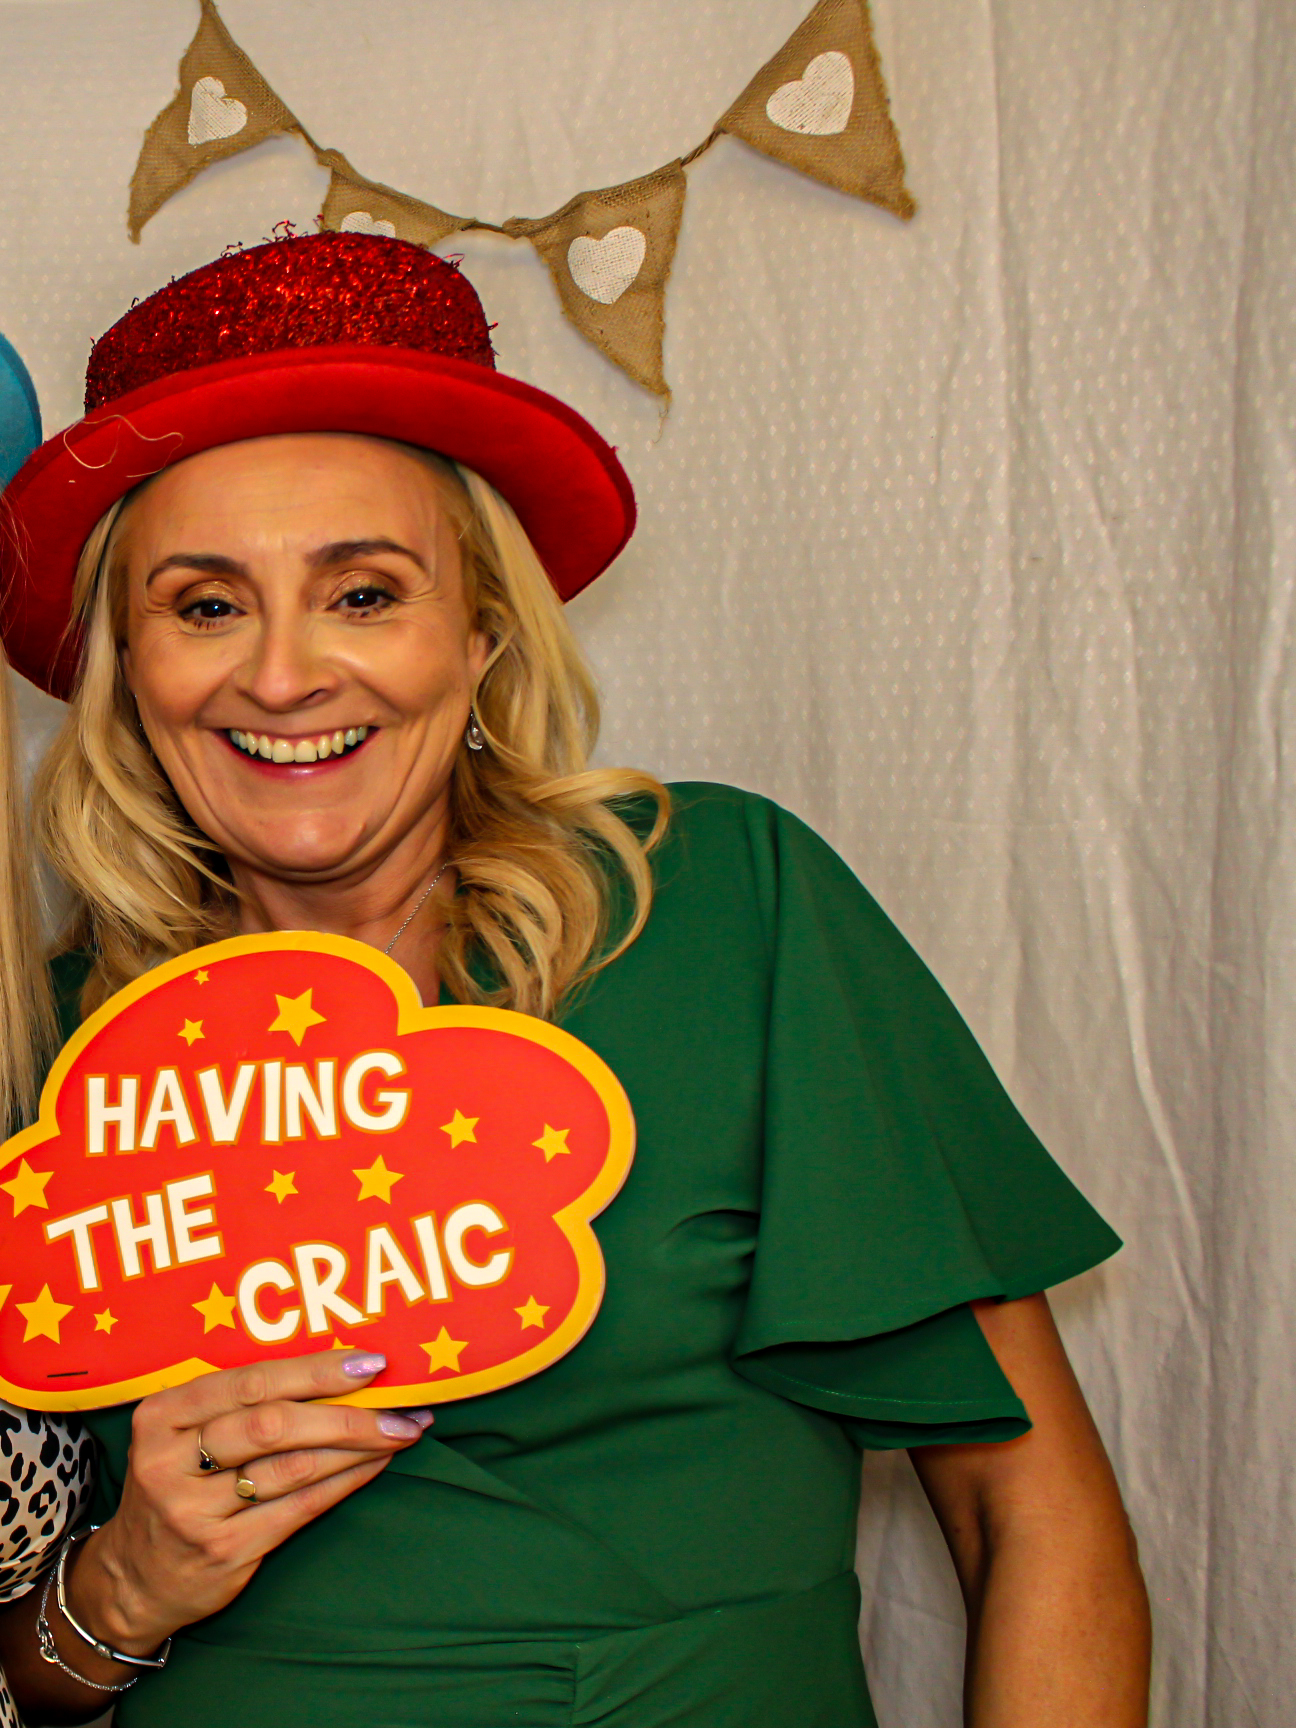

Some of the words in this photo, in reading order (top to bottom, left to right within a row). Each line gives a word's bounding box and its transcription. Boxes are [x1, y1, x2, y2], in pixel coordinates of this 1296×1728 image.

[85, 1050, 411, 1155] HAVING
[45, 1174, 223, 1291] THE
[237, 1202, 513, 1344] CRAIC
